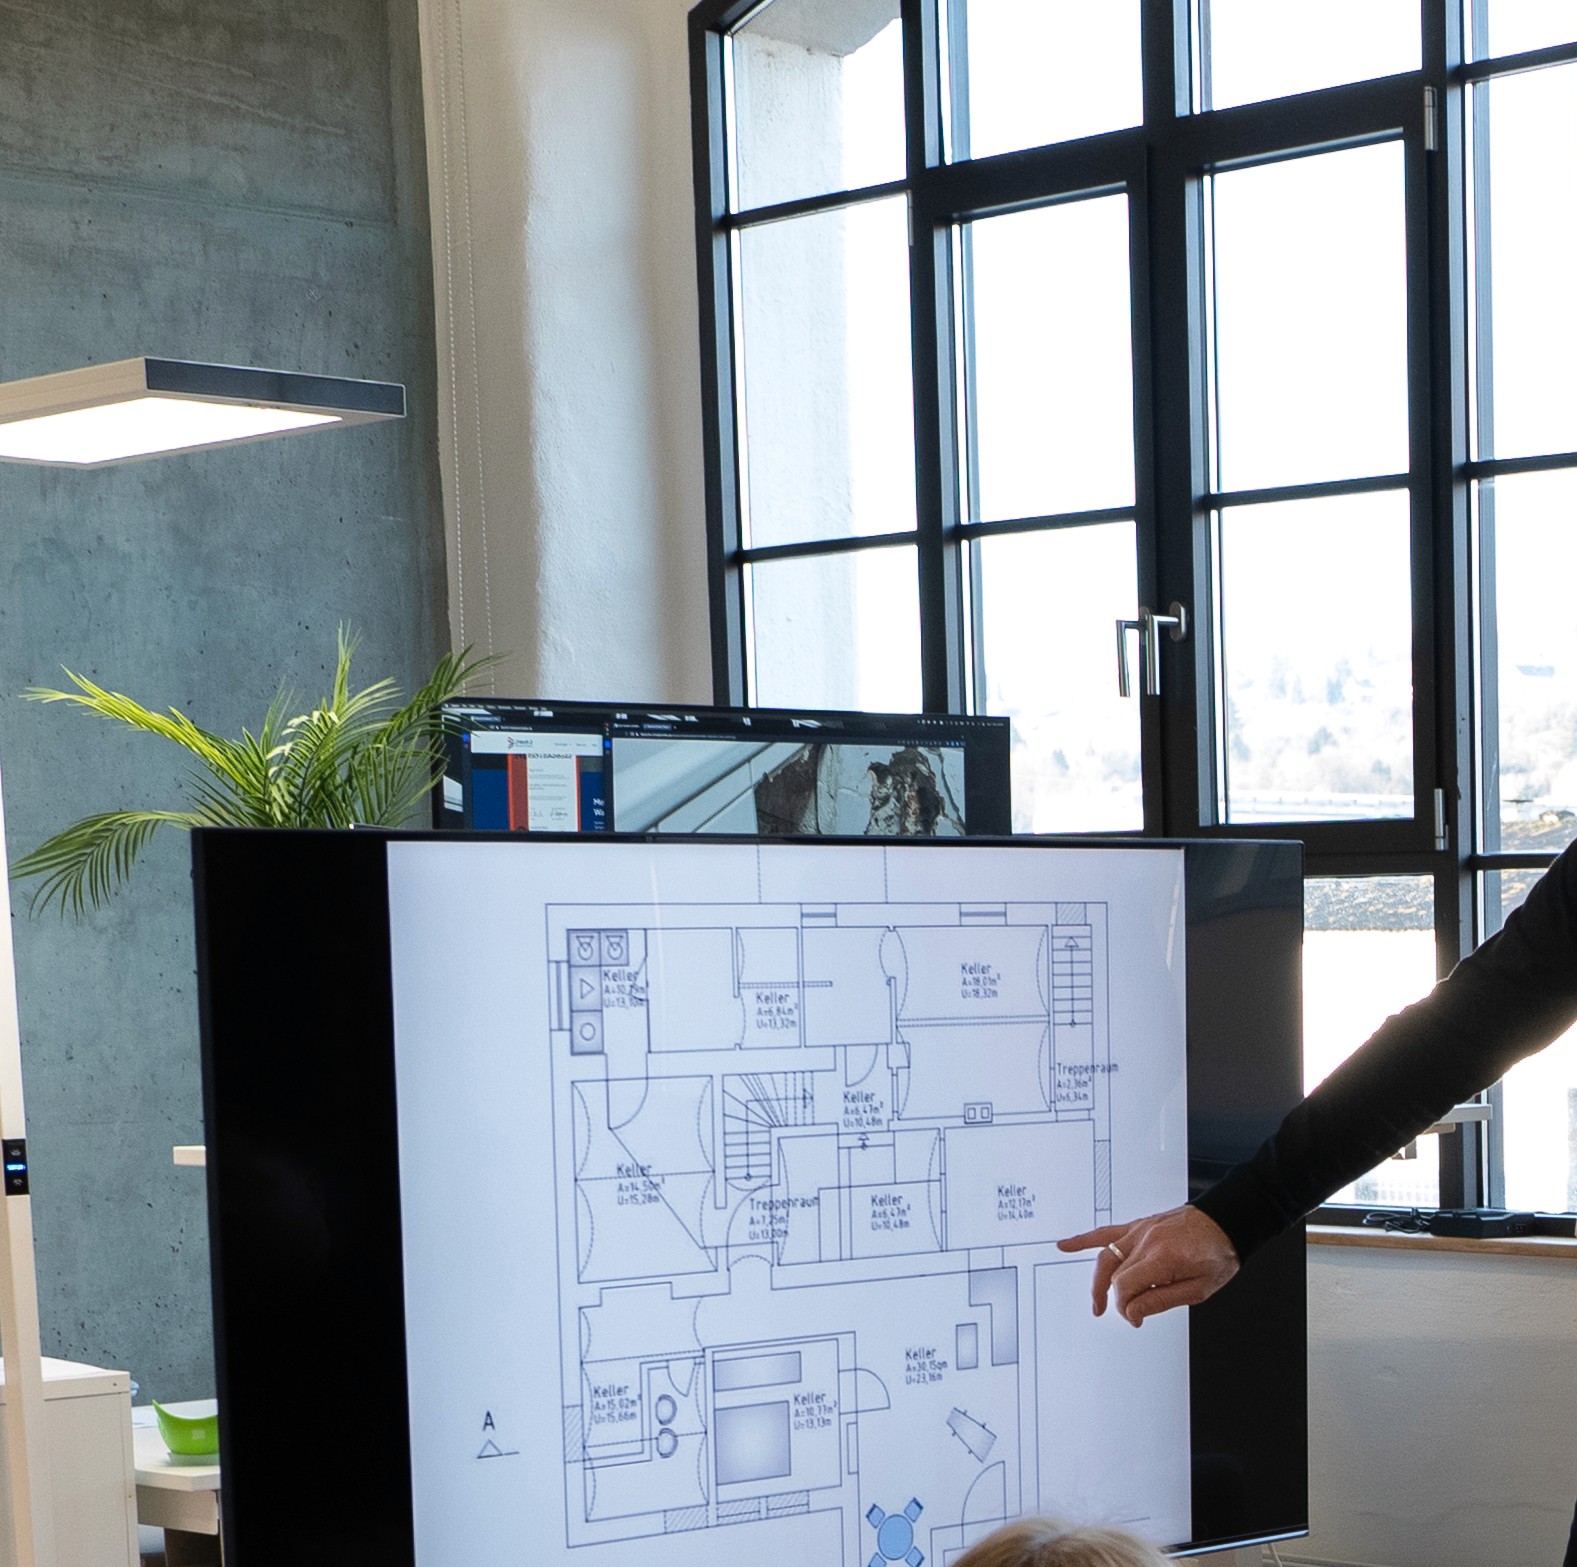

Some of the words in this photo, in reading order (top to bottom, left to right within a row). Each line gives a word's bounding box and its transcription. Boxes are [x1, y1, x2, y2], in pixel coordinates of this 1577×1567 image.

[603, 969, 639, 982] Keller
[961, 963, 991, 975] Keller
[756, 992, 790, 1005] Keller
[1057, 1062, 1119, 1077] Treppenraum
[843, 1091, 876, 1103] Keller
[617, 1163, 652, 1178] Keller
[997, 1185, 1027, 1197] Keller
[749, 1197, 820, 1211] Treppenraum
[871, 1194, 903, 1206] Keller
[905, 1347, 936, 1361] Keller
[593, 1384, 629, 1398] Keller
[793, 1391, 826, 1405] Keller
[482, 1410, 496, 1431] A
